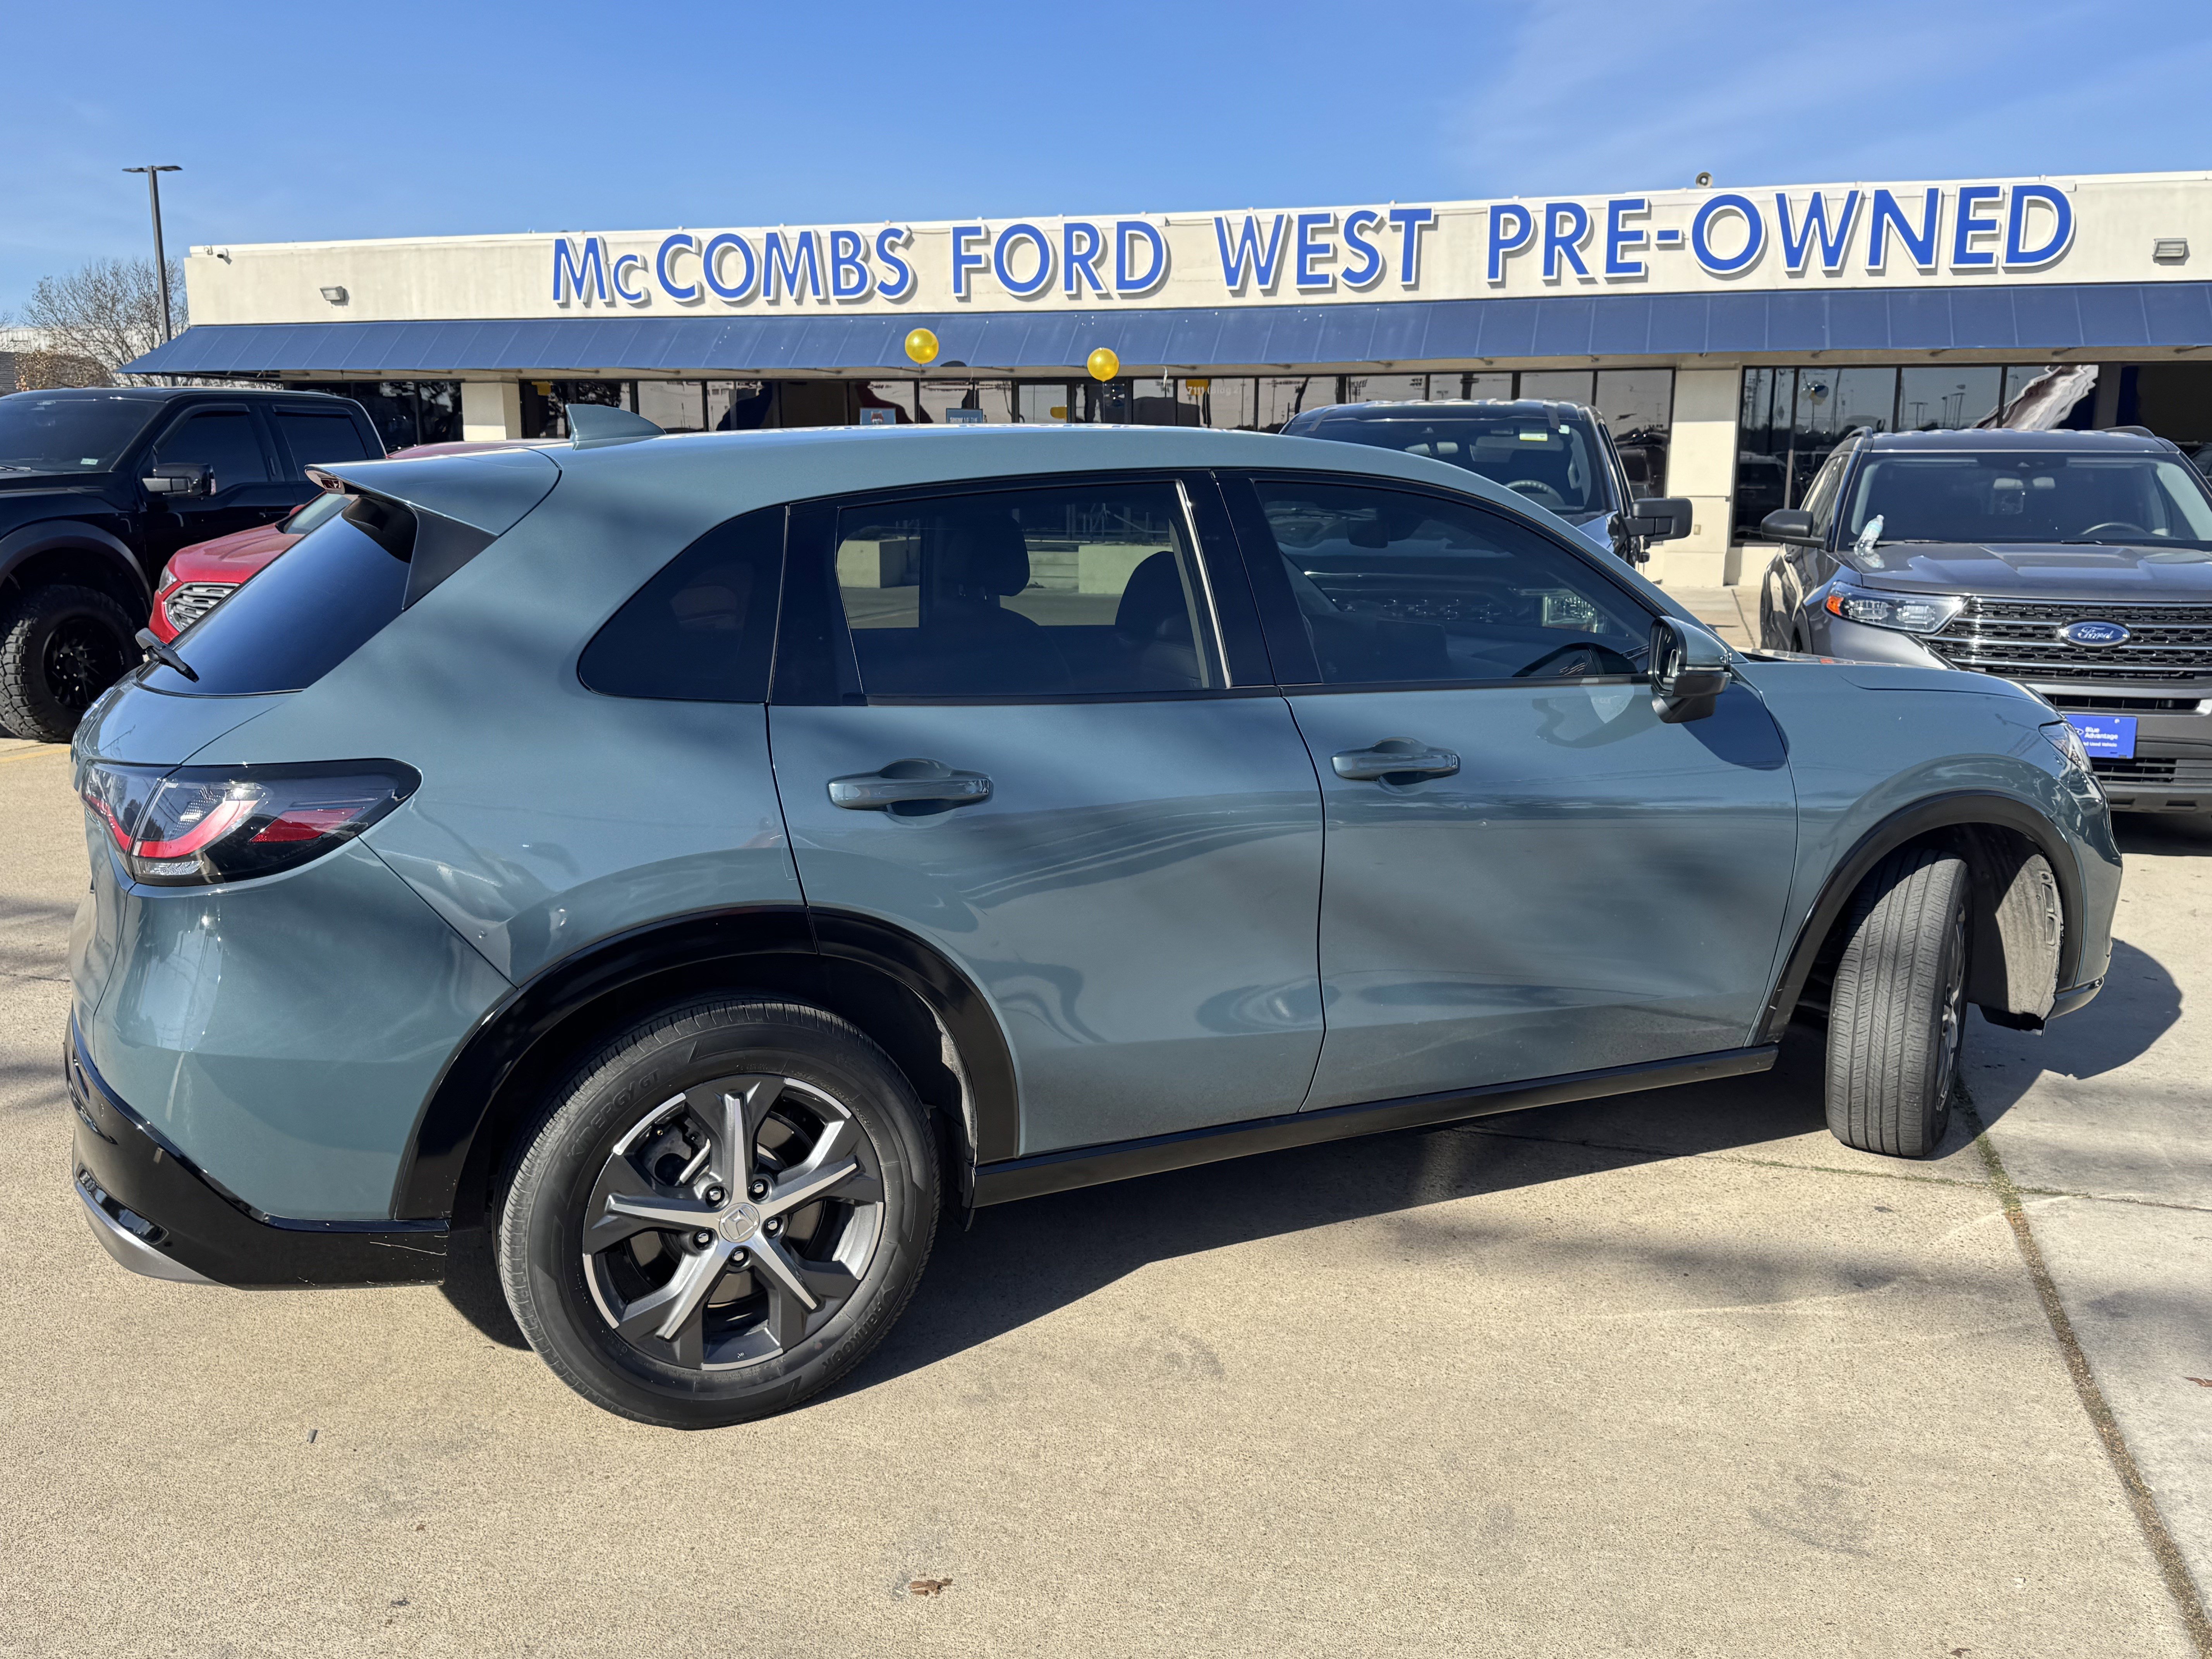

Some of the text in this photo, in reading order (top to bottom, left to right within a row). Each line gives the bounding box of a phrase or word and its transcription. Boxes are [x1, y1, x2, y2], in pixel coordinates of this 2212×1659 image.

[552, 182, 2076, 304] McCOMBS FORD WEST PRE-OWNED
[2077, 626, 2114, 640] Ford
[2084, 732, 2118, 740] Advantage
